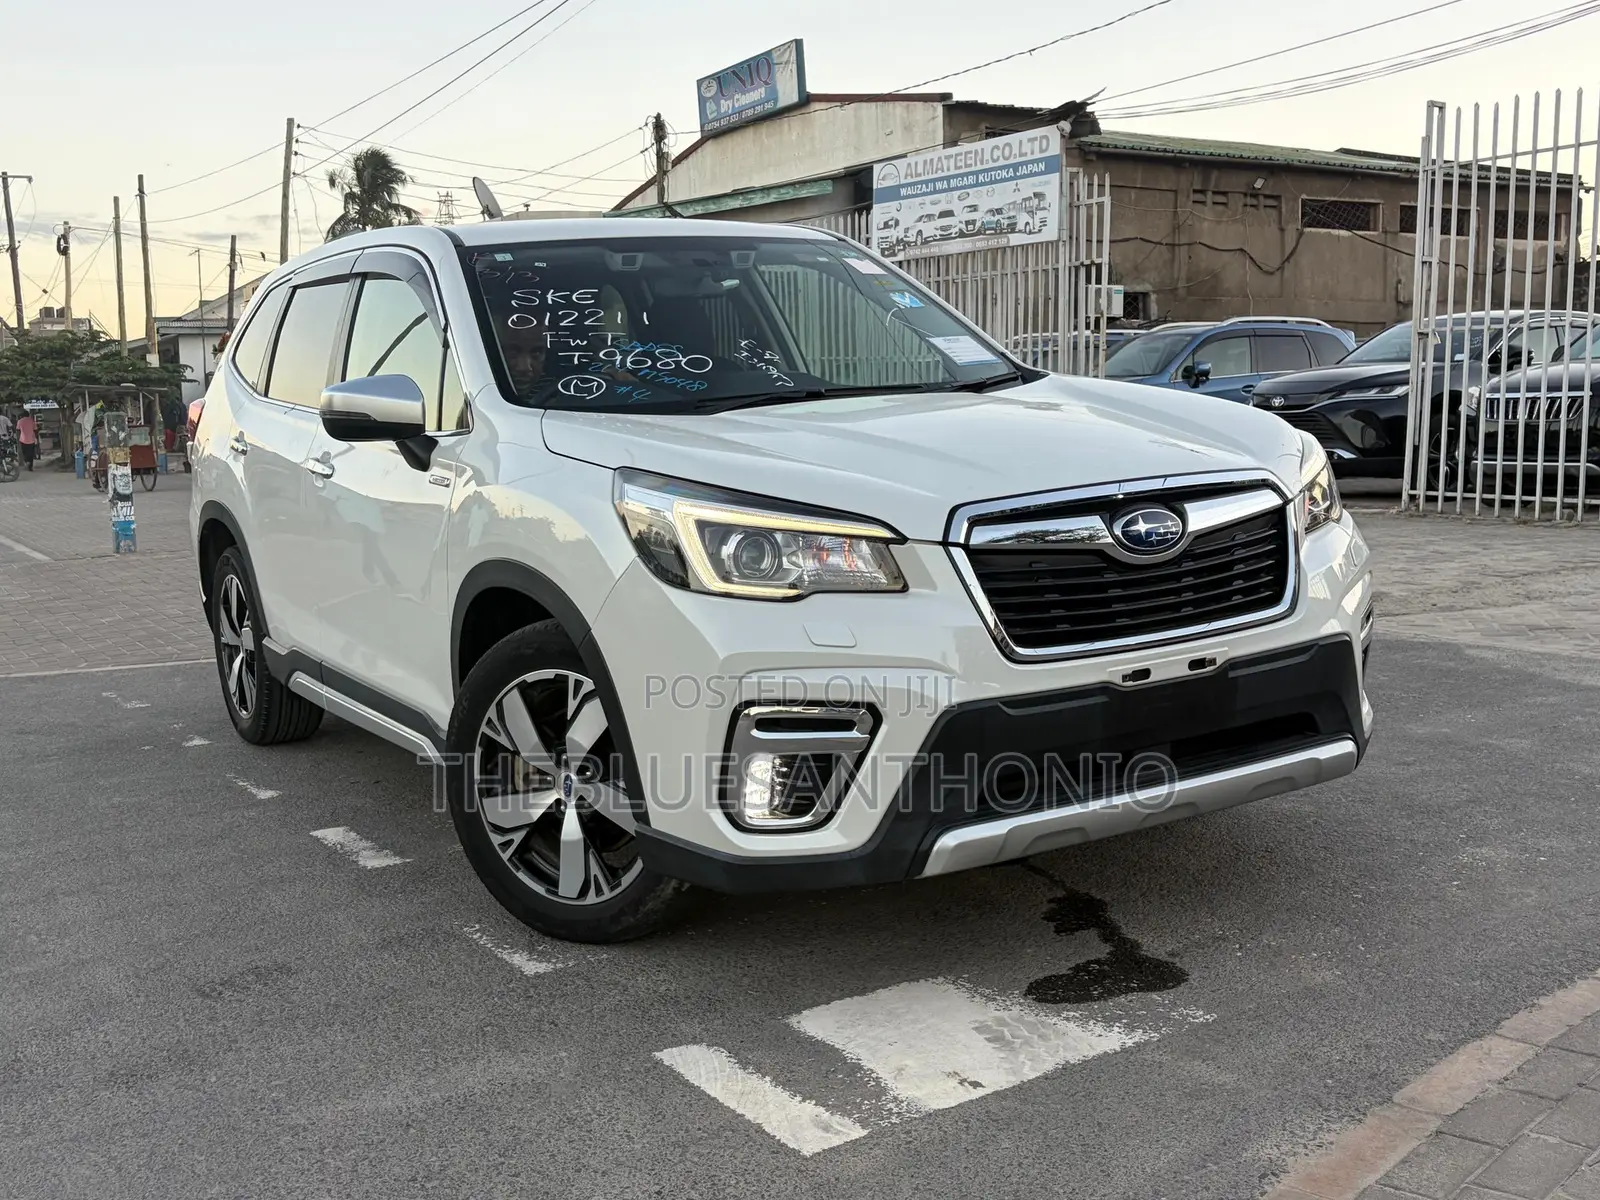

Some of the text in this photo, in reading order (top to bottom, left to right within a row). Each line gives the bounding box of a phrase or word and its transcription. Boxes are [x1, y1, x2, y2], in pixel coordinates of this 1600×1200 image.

[716, 56, 772, 97] UNIQ
[720, 98, 733, 113] Dry
[904, 134, 1050, 180] ALMATEEN.CO.LTD
[900, 162, 1046, 197] WAUZAJI WA MGARI KUTOKA JAPAN
[511, 289, 599, 308] SKE
